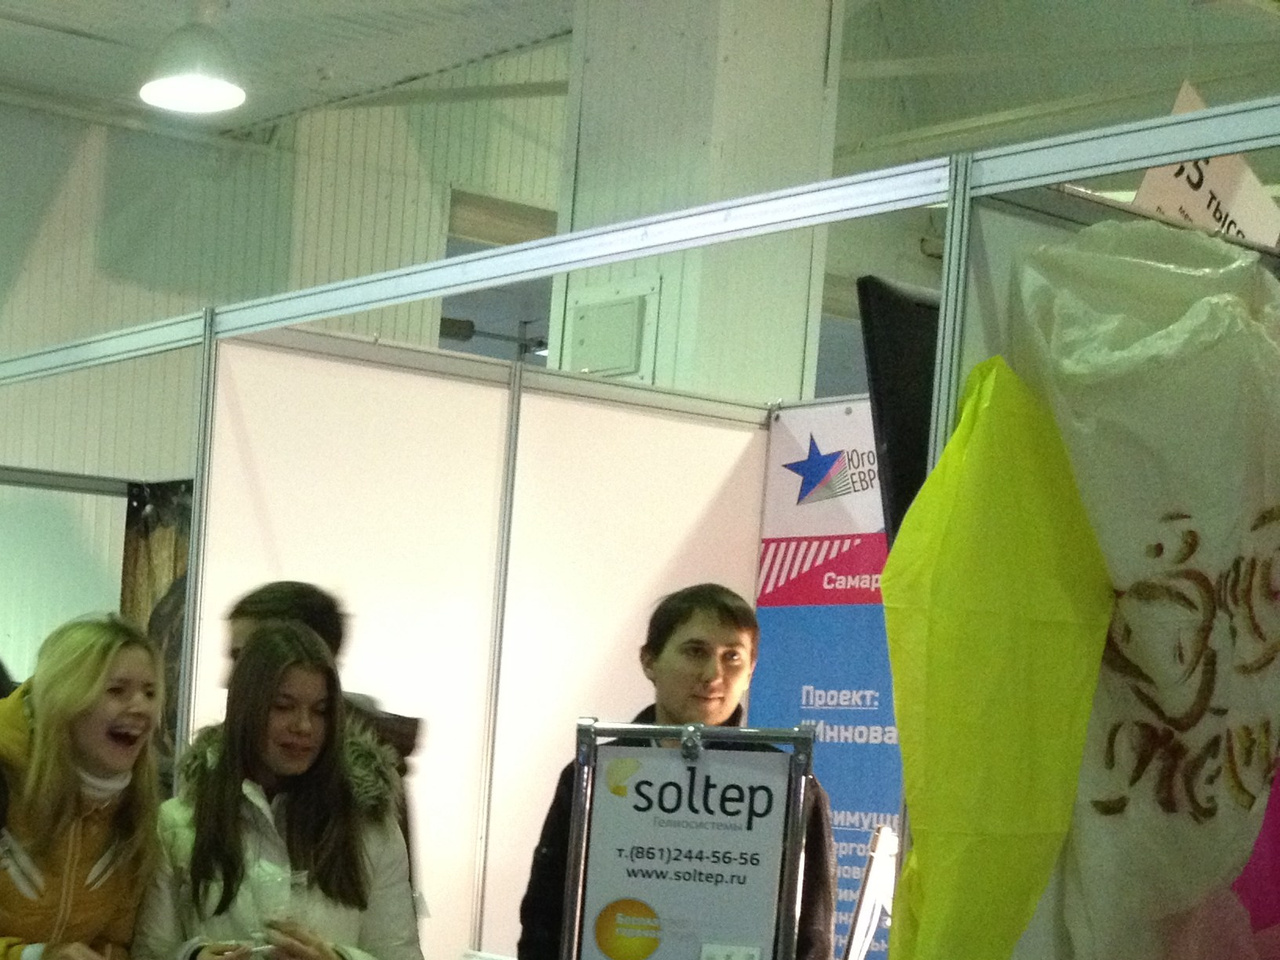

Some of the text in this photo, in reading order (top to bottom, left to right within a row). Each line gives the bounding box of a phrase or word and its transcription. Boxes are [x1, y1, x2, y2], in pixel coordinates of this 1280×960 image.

[801, 685, 879, 708] Проект:
[632, 766, 774, 831] soltep
[626, 868, 747, 886] www.soltep.ru
